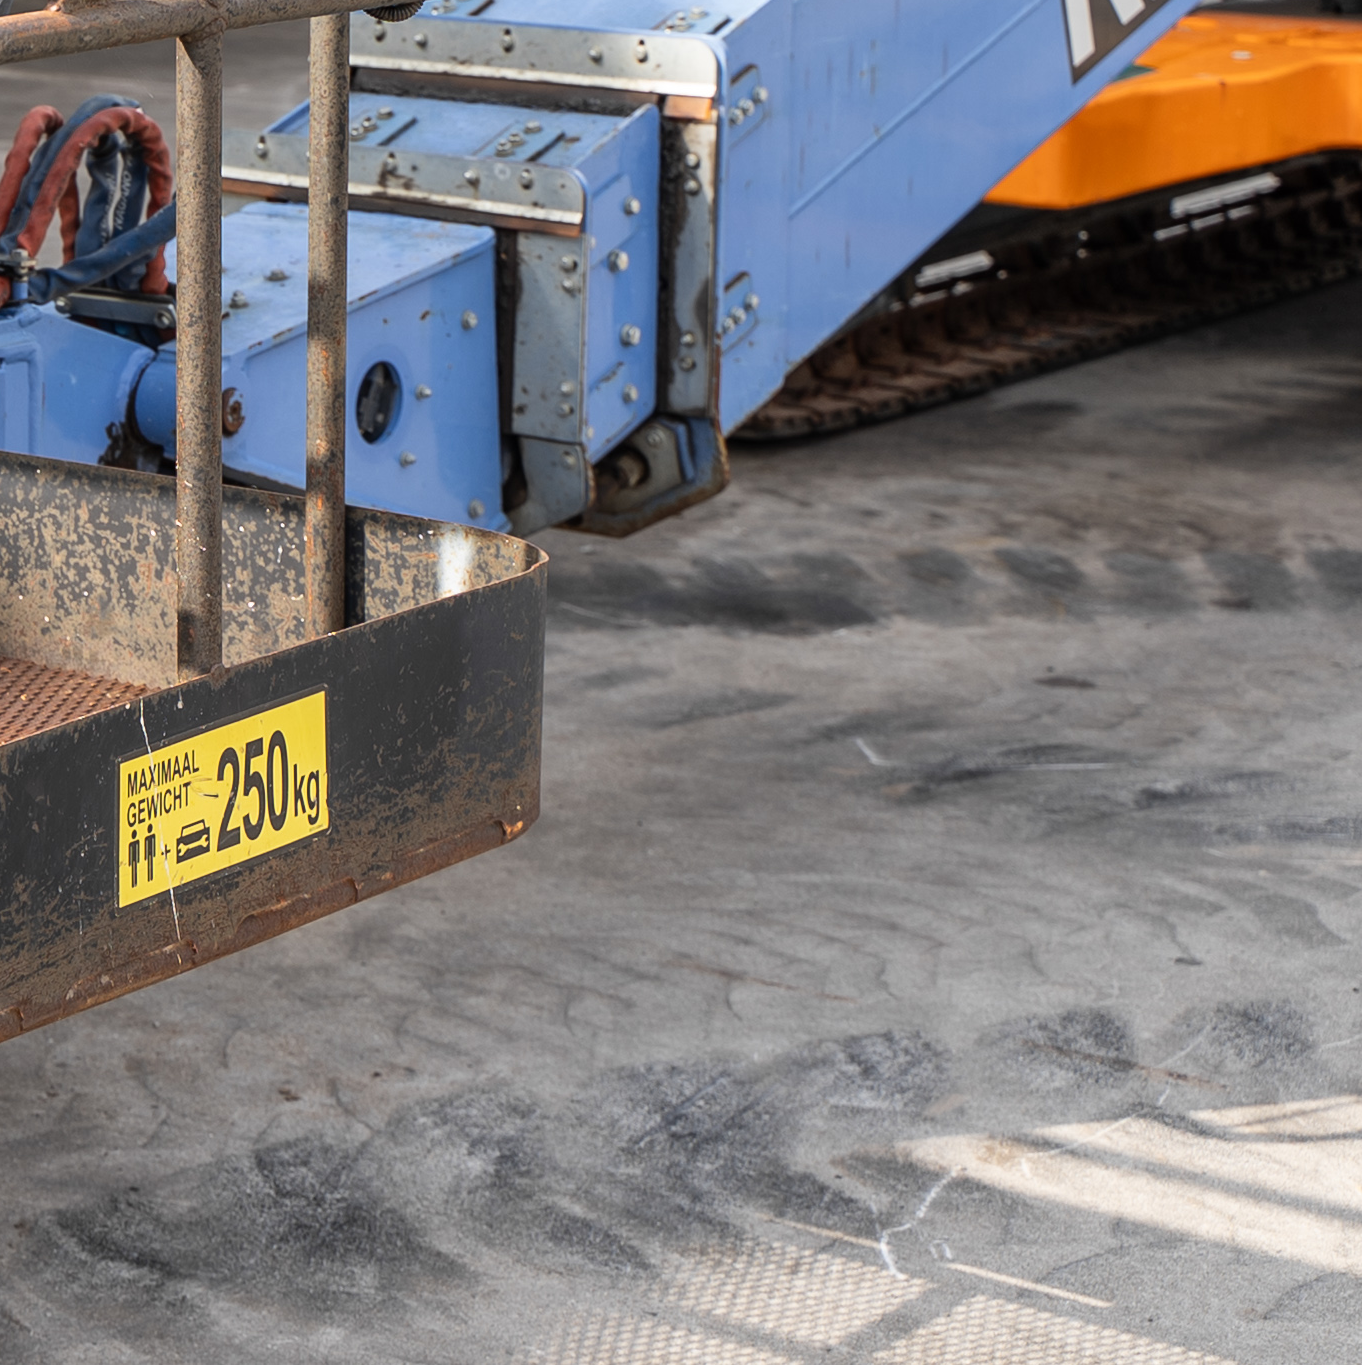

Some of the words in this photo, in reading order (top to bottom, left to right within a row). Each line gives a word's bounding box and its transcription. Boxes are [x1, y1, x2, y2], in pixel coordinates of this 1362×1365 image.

[114, 172, 133, 231] NAGANO
[127, 750, 200, 798] MAXIMAAL
[127, 782, 192, 828] GEWICHT
